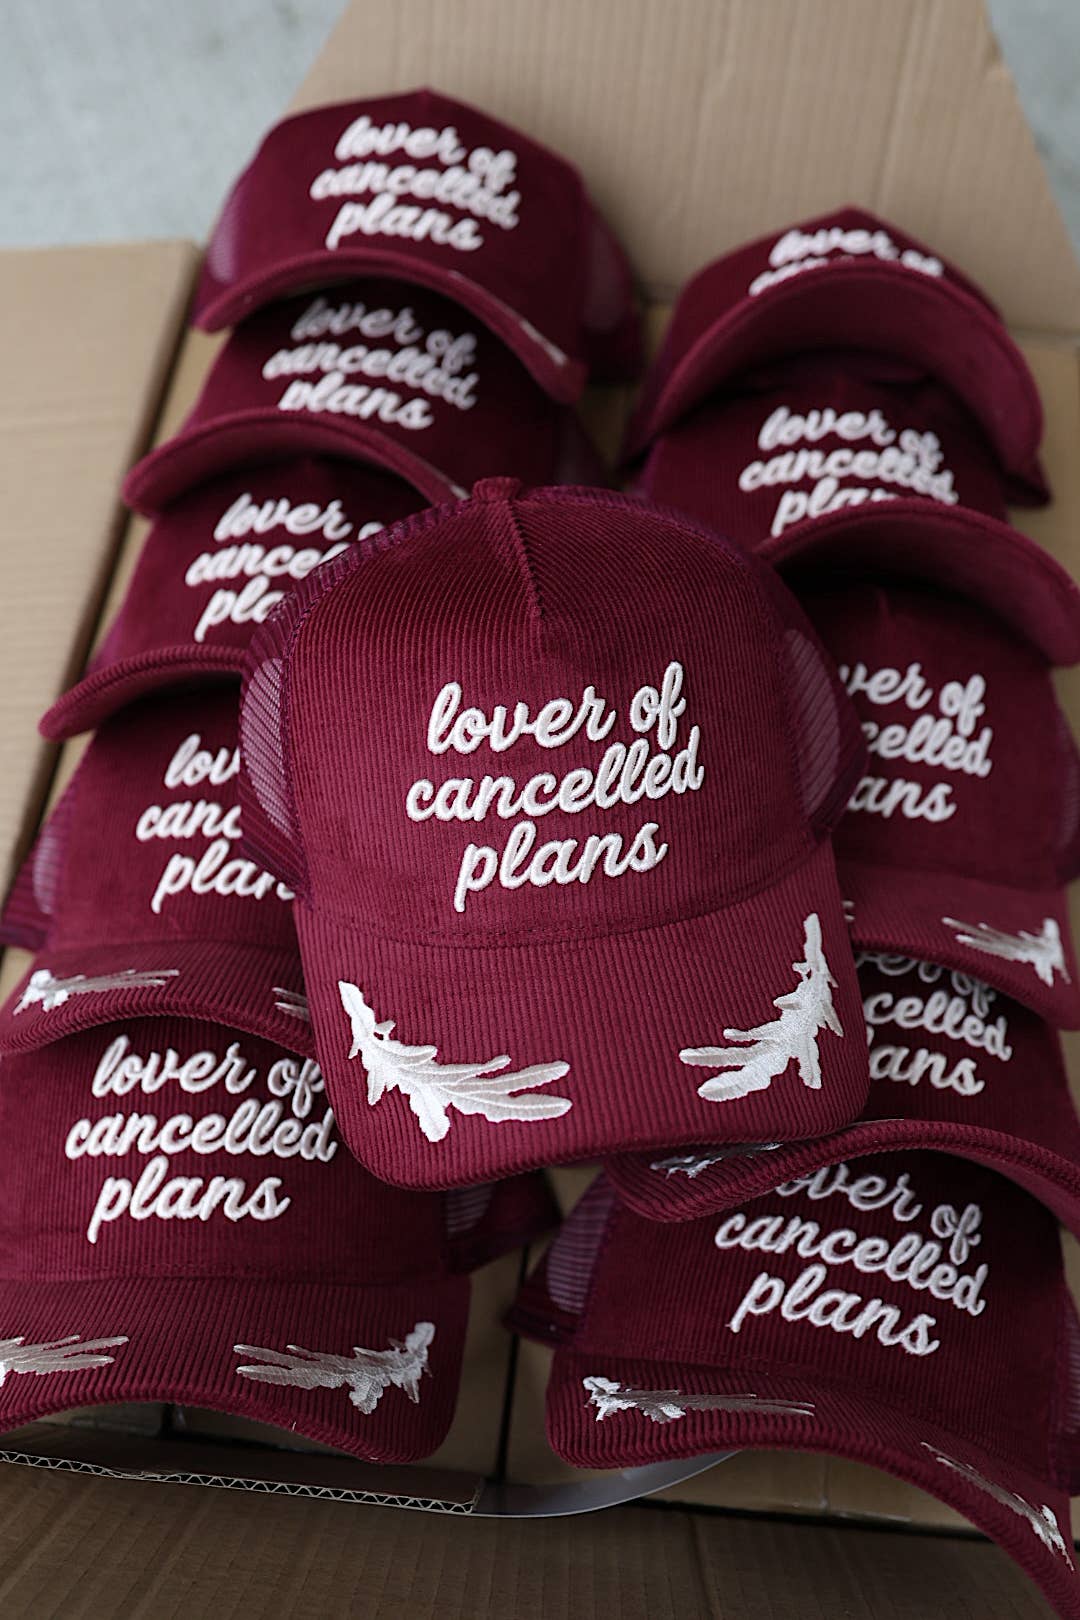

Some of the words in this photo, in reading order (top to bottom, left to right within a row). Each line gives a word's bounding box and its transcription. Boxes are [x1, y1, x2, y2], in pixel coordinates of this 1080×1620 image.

[334, 115, 467, 165] lover
[325, 191, 484, 251] plans
[291, 298, 423, 344] lover
[426, 330, 478, 374] of
[262, 342, 480, 411] cancelled
[278, 371, 434, 430] plans
[758, 405, 895, 451] lover
[738, 446, 960, 505] cancelled
[213, 492, 354, 542] lover
[427, 681, 617, 755] lover
[629, 660, 687, 751] of
[938, 673, 986, 738] of
[405, 725, 705, 823] cancelled
[453, 820, 669, 914] plans
[92, 1034, 257, 1099] lover
[267, 1057, 326, 1119] of
[867, 1024, 986, 1096] ans
[65, 1097, 339, 1163] cancelled
[87, 1154, 292, 1245] plans
[930, 1203, 982, 1265] of
[714, 1212, 989, 1317] cancelled
[726, 1262, 941, 1357] plans
